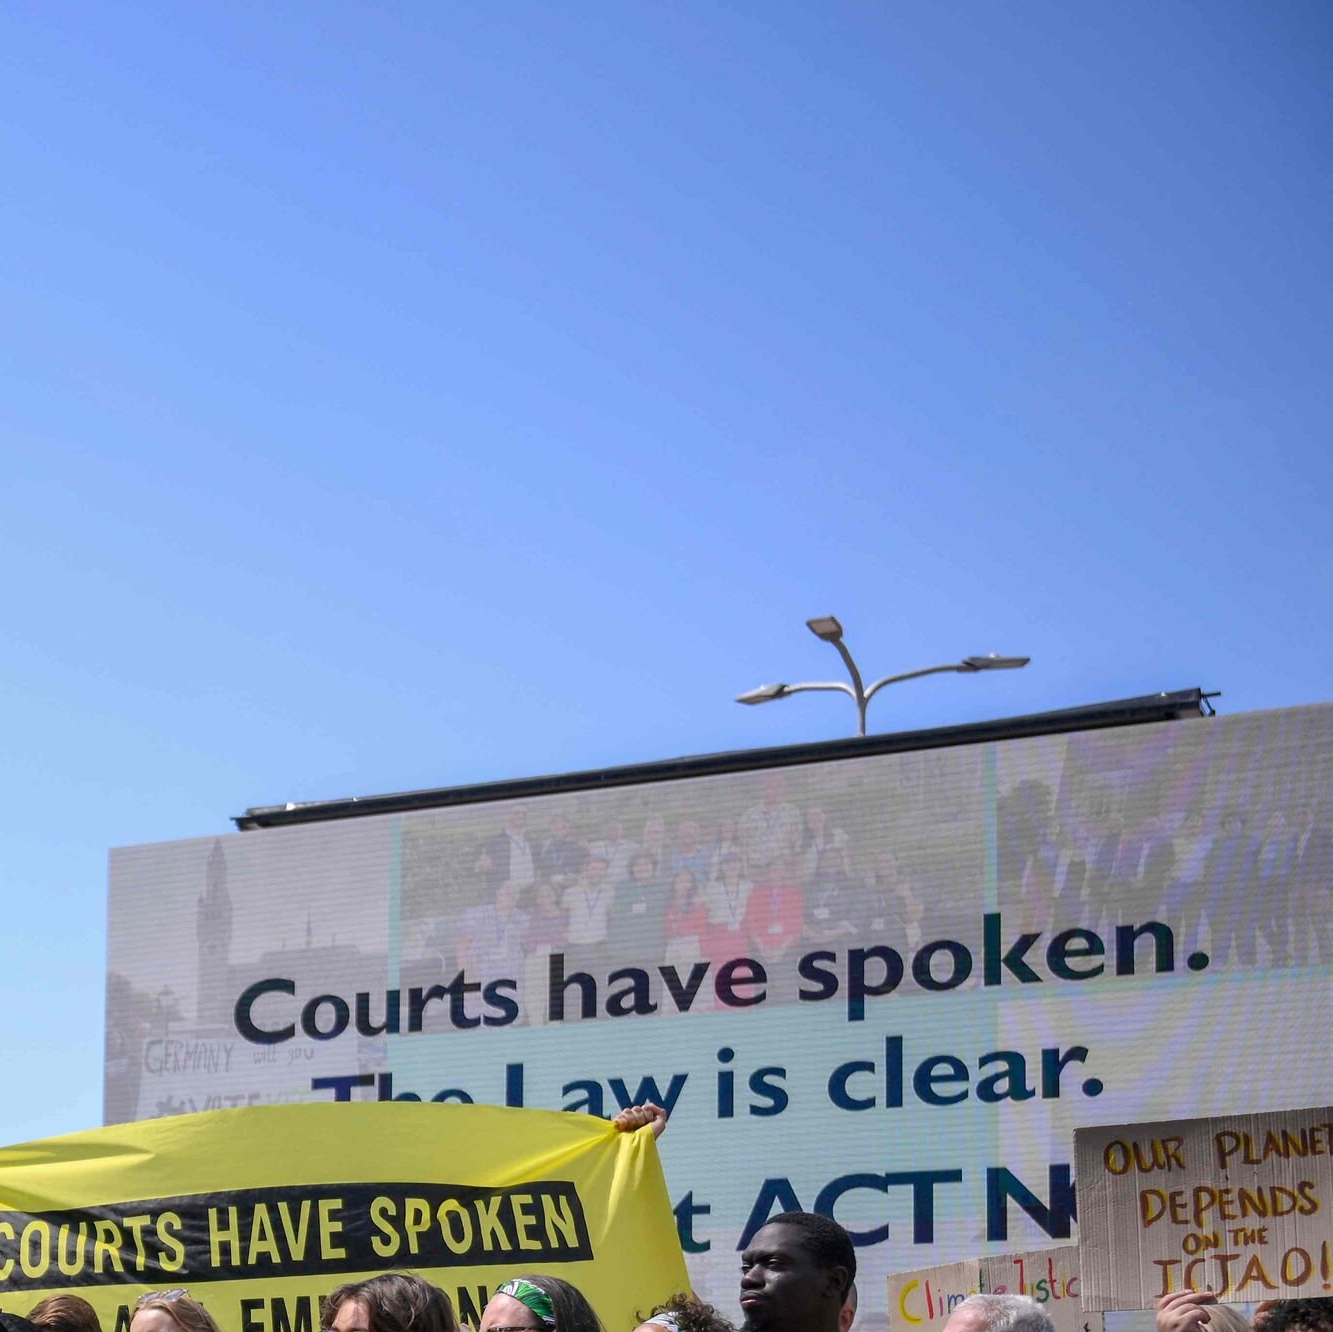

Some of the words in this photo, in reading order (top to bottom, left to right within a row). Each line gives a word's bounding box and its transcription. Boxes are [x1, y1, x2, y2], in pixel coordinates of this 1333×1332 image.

[234, 969, 519, 1044] Courts
[548, 953, 768, 1022] have
[798, 913, 1210, 1022] spoken.
[143, 1040, 233, 1074] GERMANY
[717, 1048, 789, 1118] is
[828, 1035, 1104, 1110] clear.
[1103, 1136, 1185, 1175] OUR
[208, 1199, 346, 1267] HAVE
[370, 1194, 579, 1258] SPOKEN
[736, 1168, 963, 1251] ACT
[1140, 1180, 1319, 1228] DEPENDS
[1183, 1230, 1219, 1255] ON
[1228, 1226, 1268, 1246] THE
